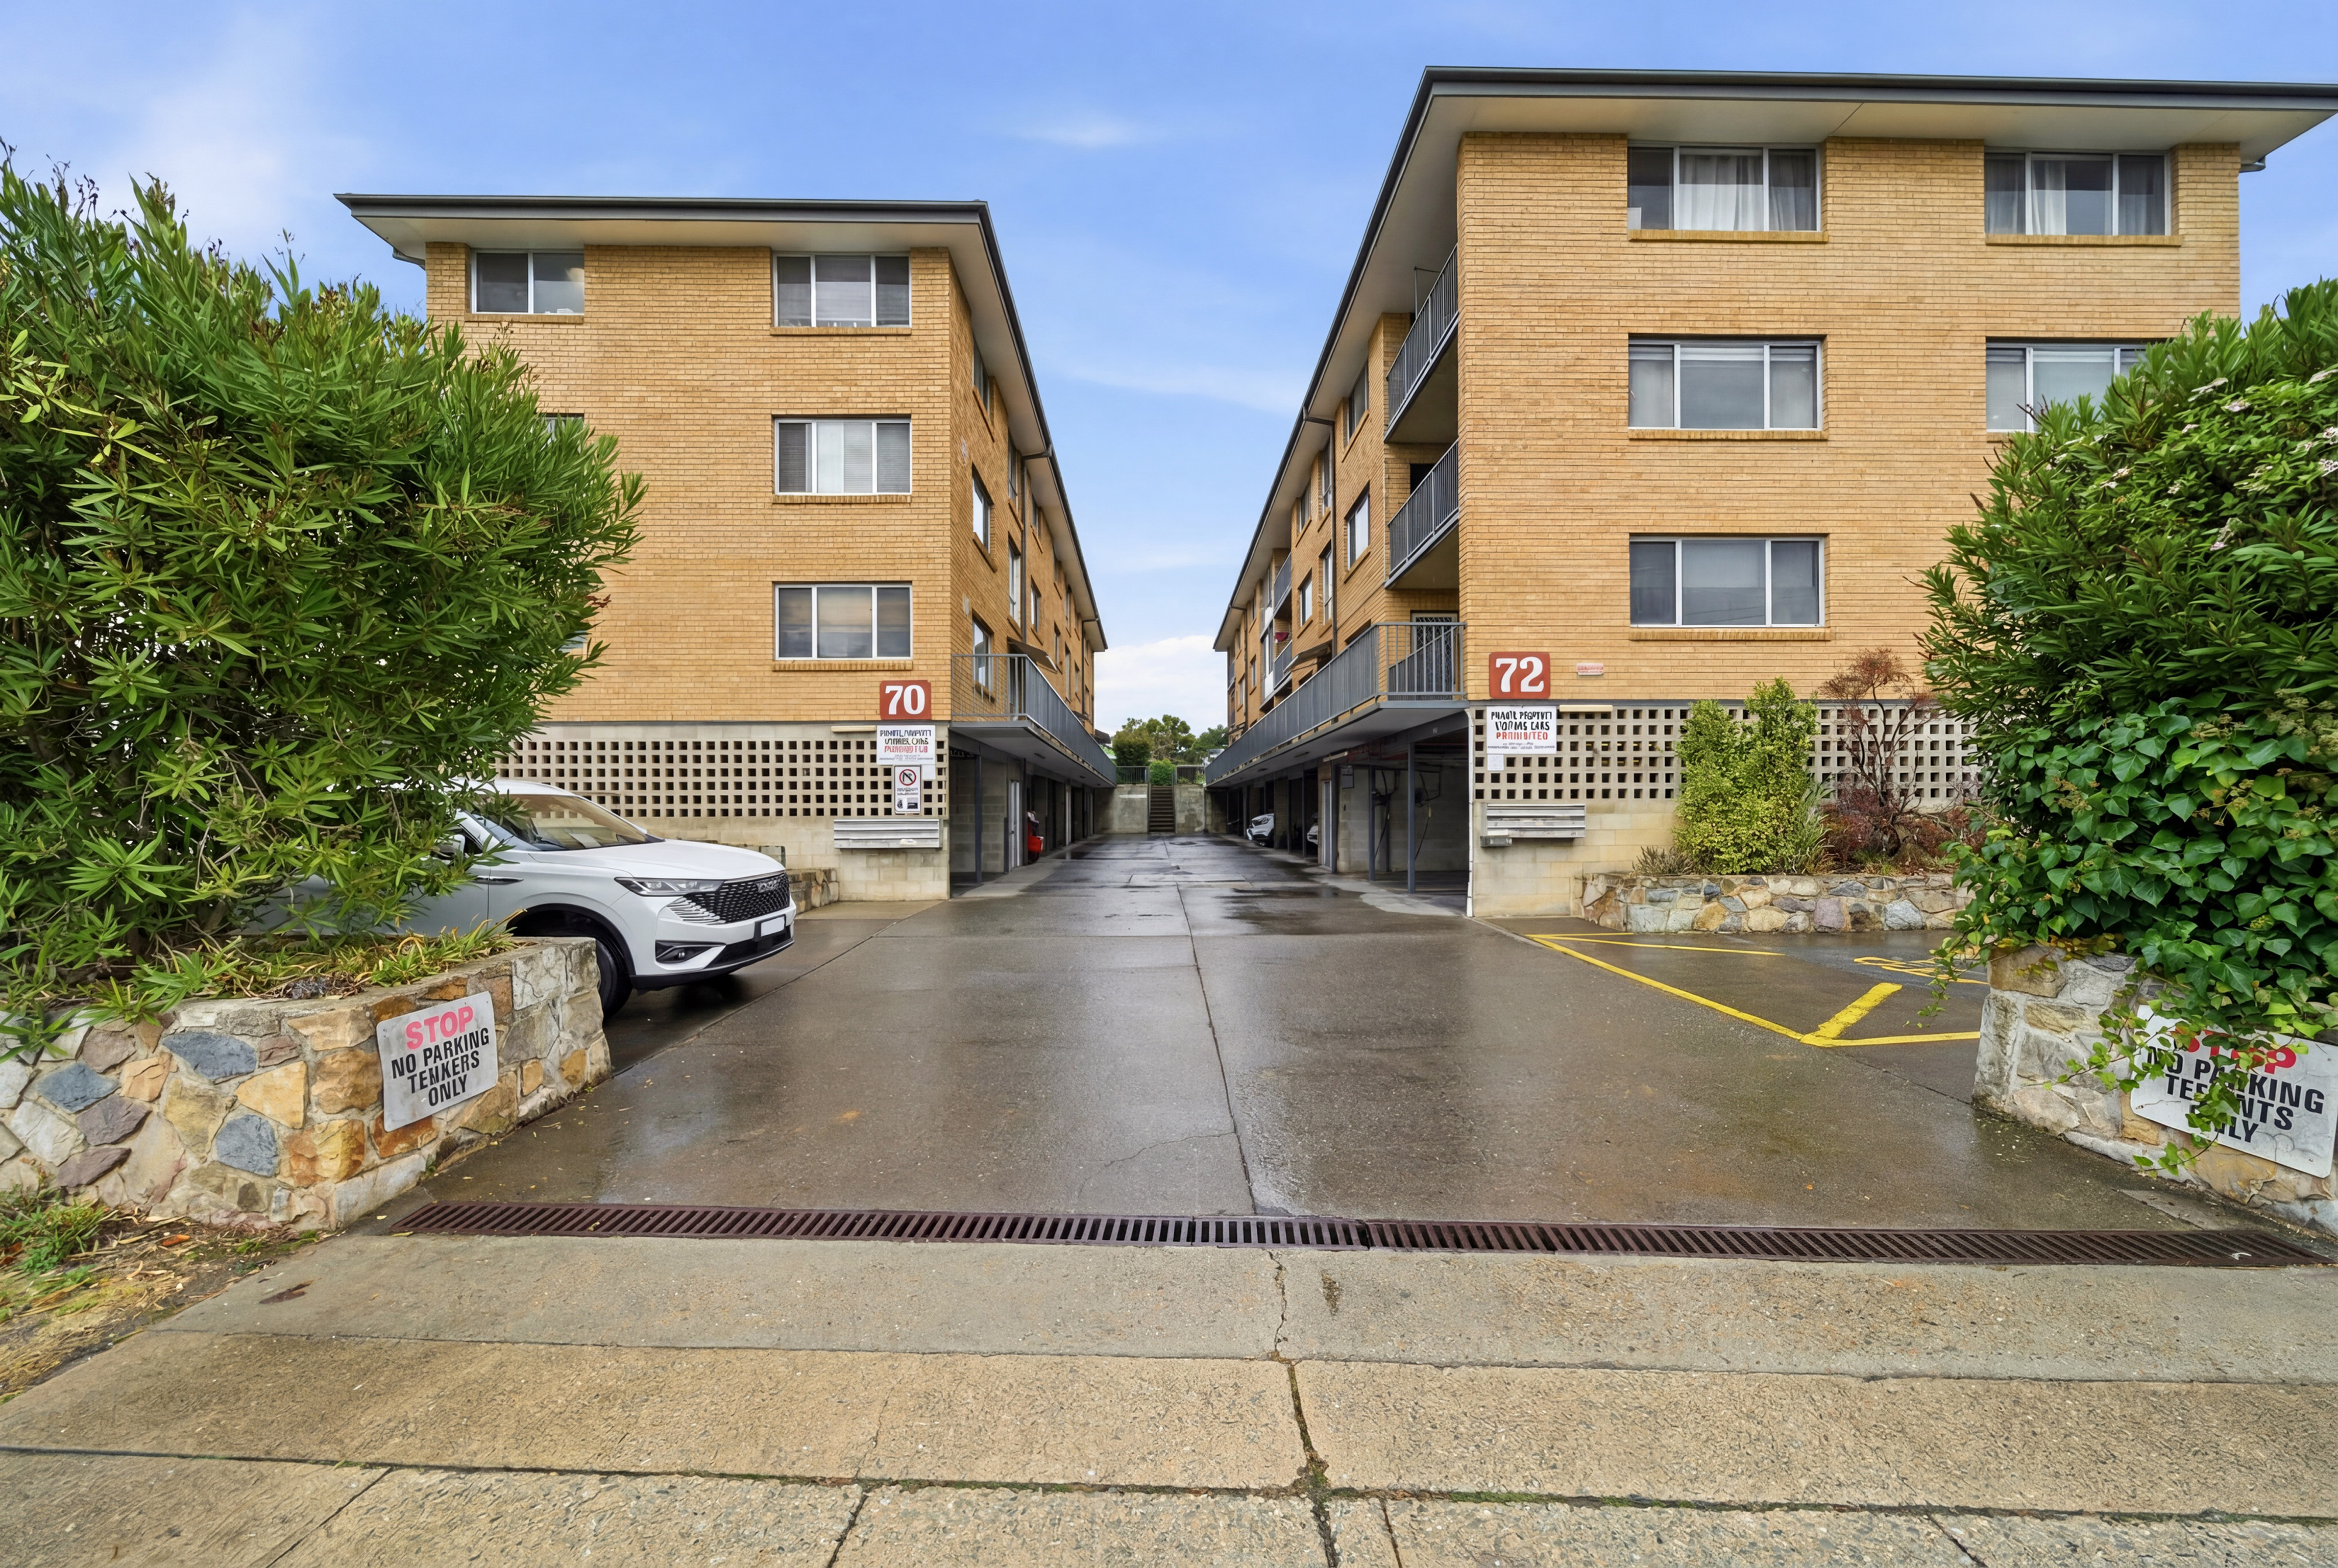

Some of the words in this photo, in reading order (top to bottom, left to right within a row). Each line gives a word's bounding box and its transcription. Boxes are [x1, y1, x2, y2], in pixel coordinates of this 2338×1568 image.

[1495, 656, 1544, 693] 72
[885, 684, 925, 715] 70
[406, 1006, 473, 1050] STOP
[391, 1053, 416, 1079] NO
[423, 1027, 489, 1067] PARKING
[428, 1074, 467, 1107] ONLY
